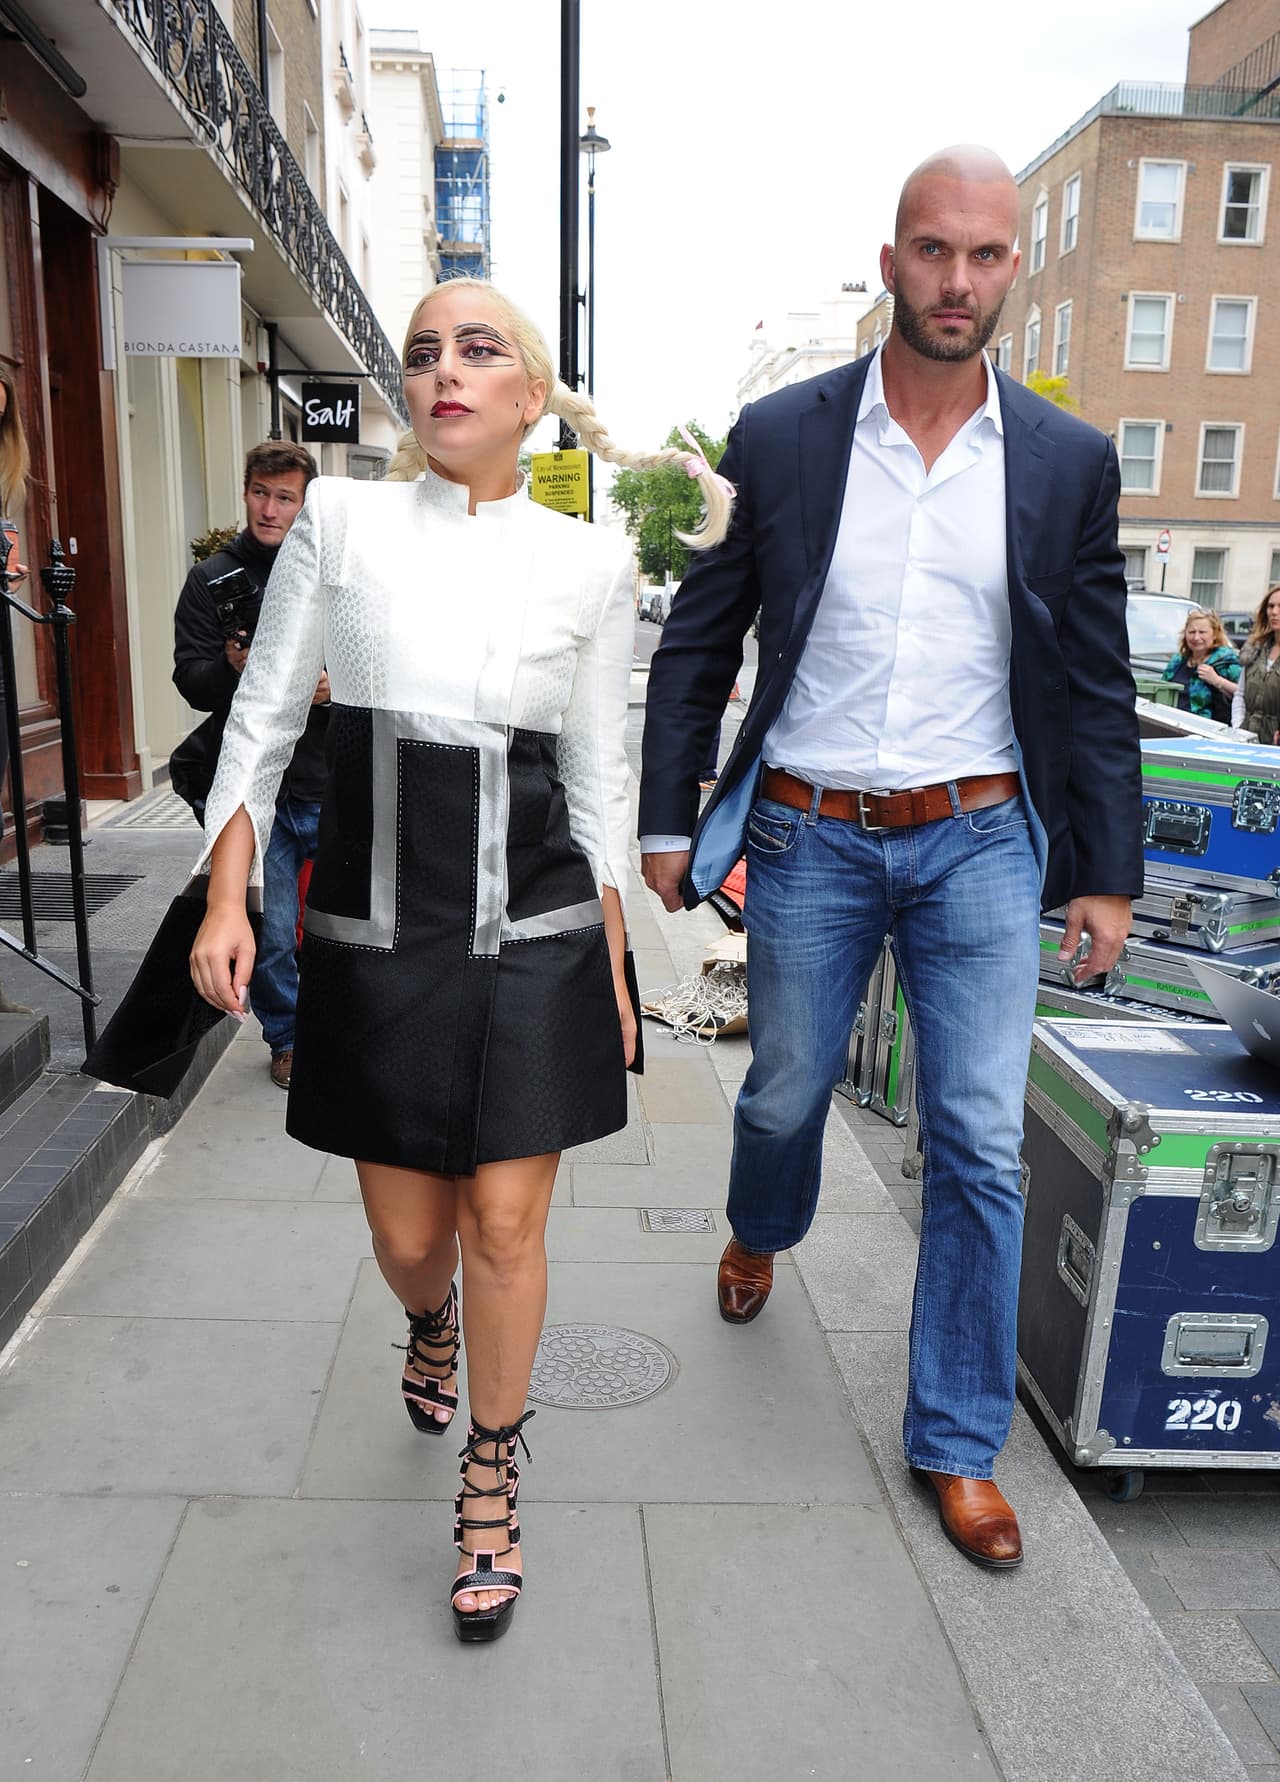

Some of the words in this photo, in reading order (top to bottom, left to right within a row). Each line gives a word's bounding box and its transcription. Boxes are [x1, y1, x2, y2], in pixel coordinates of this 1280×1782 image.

[124, 342, 175, 352] BIONDA
[179, 342, 240, 353] CASTANA
[304, 398, 356, 429] Salt
[538, 473, 581, 484] WARNING
[1183, 1089, 1264, 1103] 220
[1164, 1399, 1242, 1431] 220
